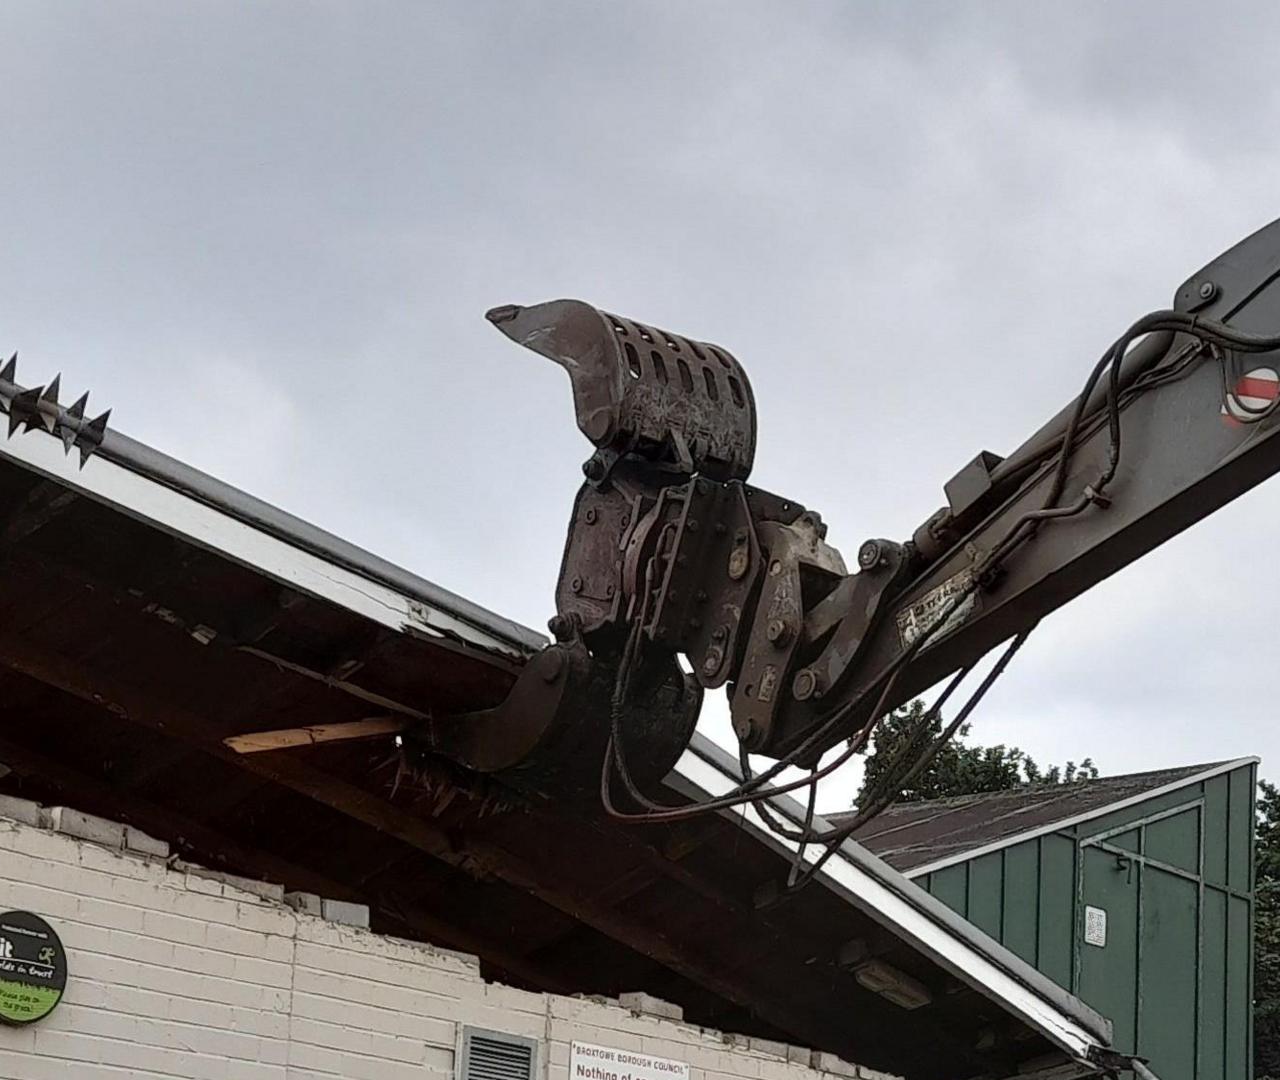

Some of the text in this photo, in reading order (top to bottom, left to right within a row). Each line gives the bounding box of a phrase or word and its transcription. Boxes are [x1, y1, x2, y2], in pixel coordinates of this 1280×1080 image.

[576, 1046, 684, 1075] BROXTOWE BOROUGH COUNCIL
